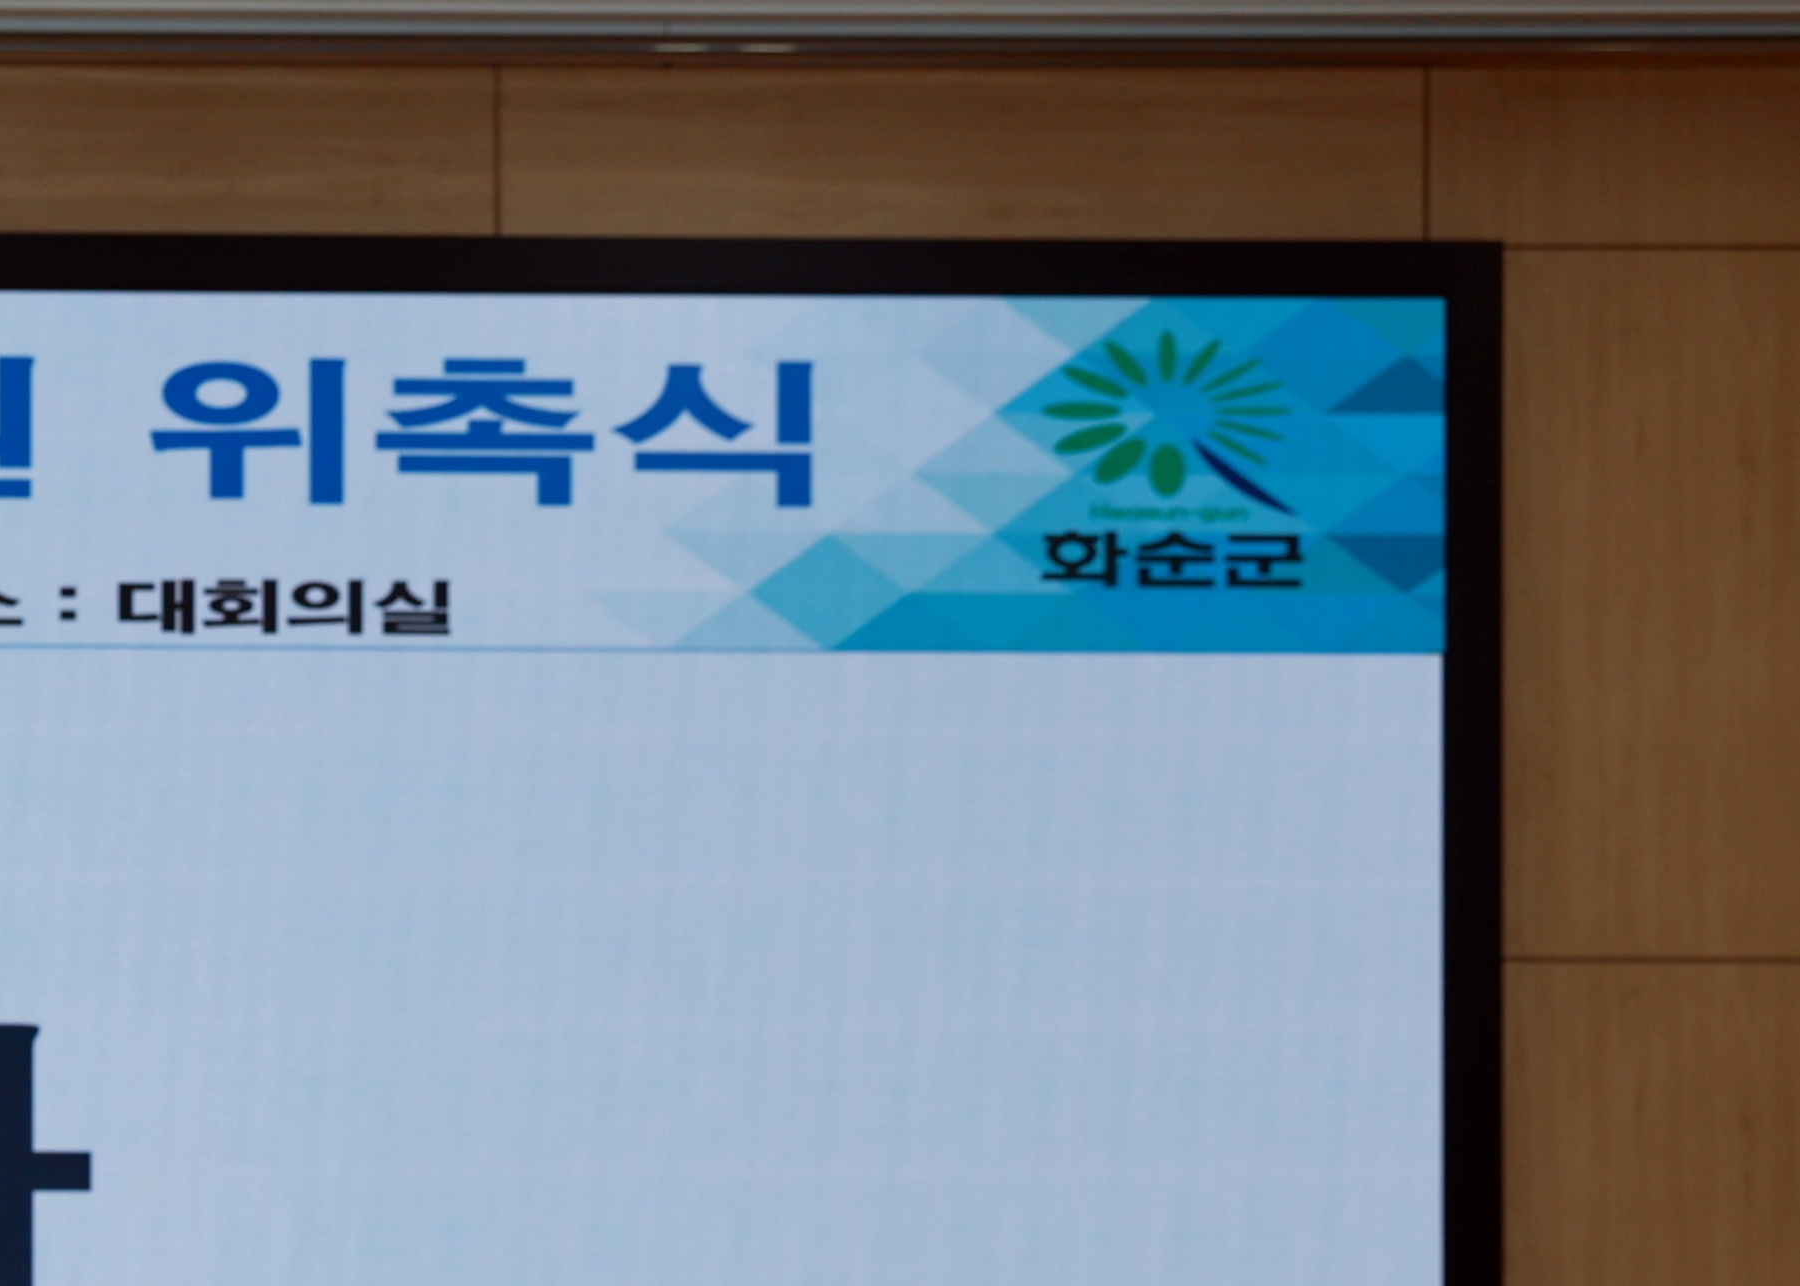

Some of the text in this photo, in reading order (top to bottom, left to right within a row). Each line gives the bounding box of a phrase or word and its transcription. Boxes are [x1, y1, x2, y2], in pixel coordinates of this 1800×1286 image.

[149, 356, 815, 509] 위촉식
[1041, 530, 1306, 590] 화순군
[59, 586, 77, 622] :
[117, 578, 451, 636] 대회의실
